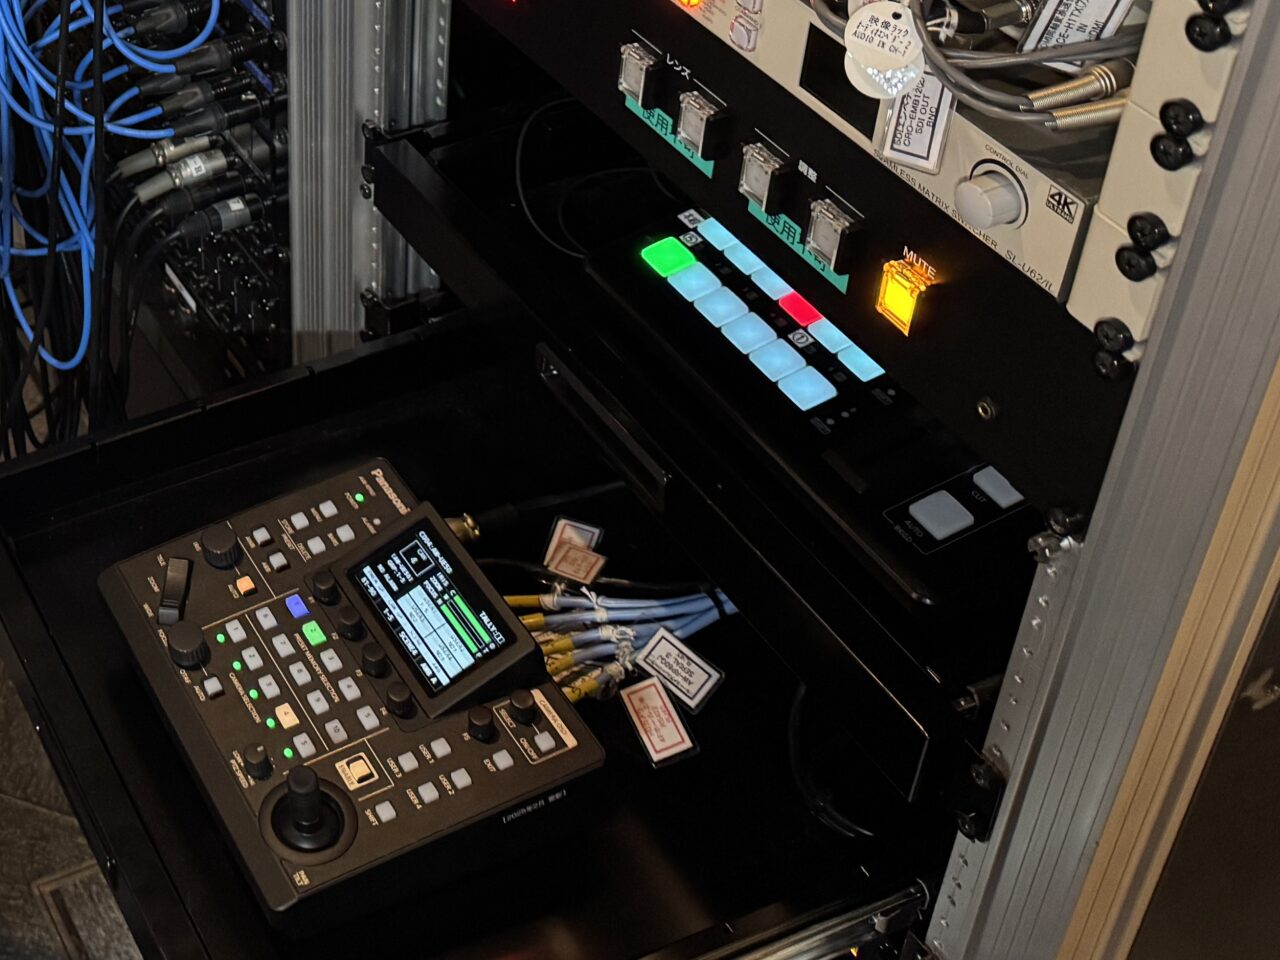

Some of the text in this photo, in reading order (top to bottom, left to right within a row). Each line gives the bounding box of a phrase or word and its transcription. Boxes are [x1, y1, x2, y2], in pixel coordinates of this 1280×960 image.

[852, 30, 874, 43] AUDIO
[1076, 23, 1088, 34] IN
[667, 53, 691, 80] レンズ
[920, 94, 930, 116] OUT
[926, 107, 937, 127] BNC
[984, 144, 1029, 180] CONTROL DIAL
[918, 183, 950, 211] MATRIX
[1049, 191, 1076, 217] 4K
[902, 246, 936, 281] MUTE
[371, 468, 411, 515] Panasonic
[498, 708, 516, 728] SELECT
[419, 743, 432, 758] USER
[386, 758, 399, 773] USER
[438, 774, 451, 789] USER
[406, 788, 419, 803] USER
[364, 808, 379, 827] SHIFT
